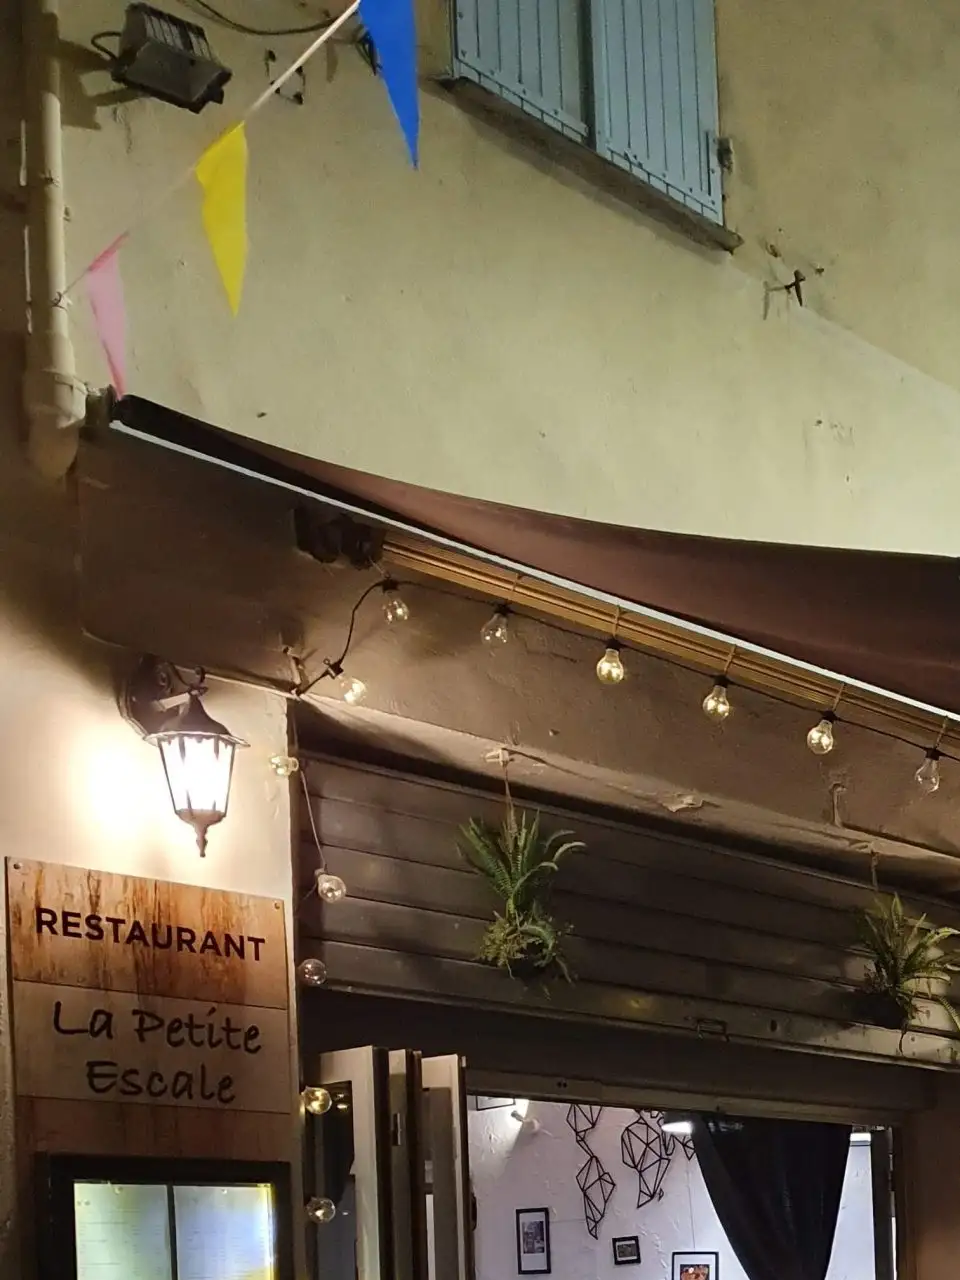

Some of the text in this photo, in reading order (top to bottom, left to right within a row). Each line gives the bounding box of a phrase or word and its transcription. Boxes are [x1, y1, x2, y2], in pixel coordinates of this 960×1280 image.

[35, 906, 266, 961] RESTAURANT
[53, 1000, 262, 1054] La Petite
[86, 1060, 236, 1104] Escale
